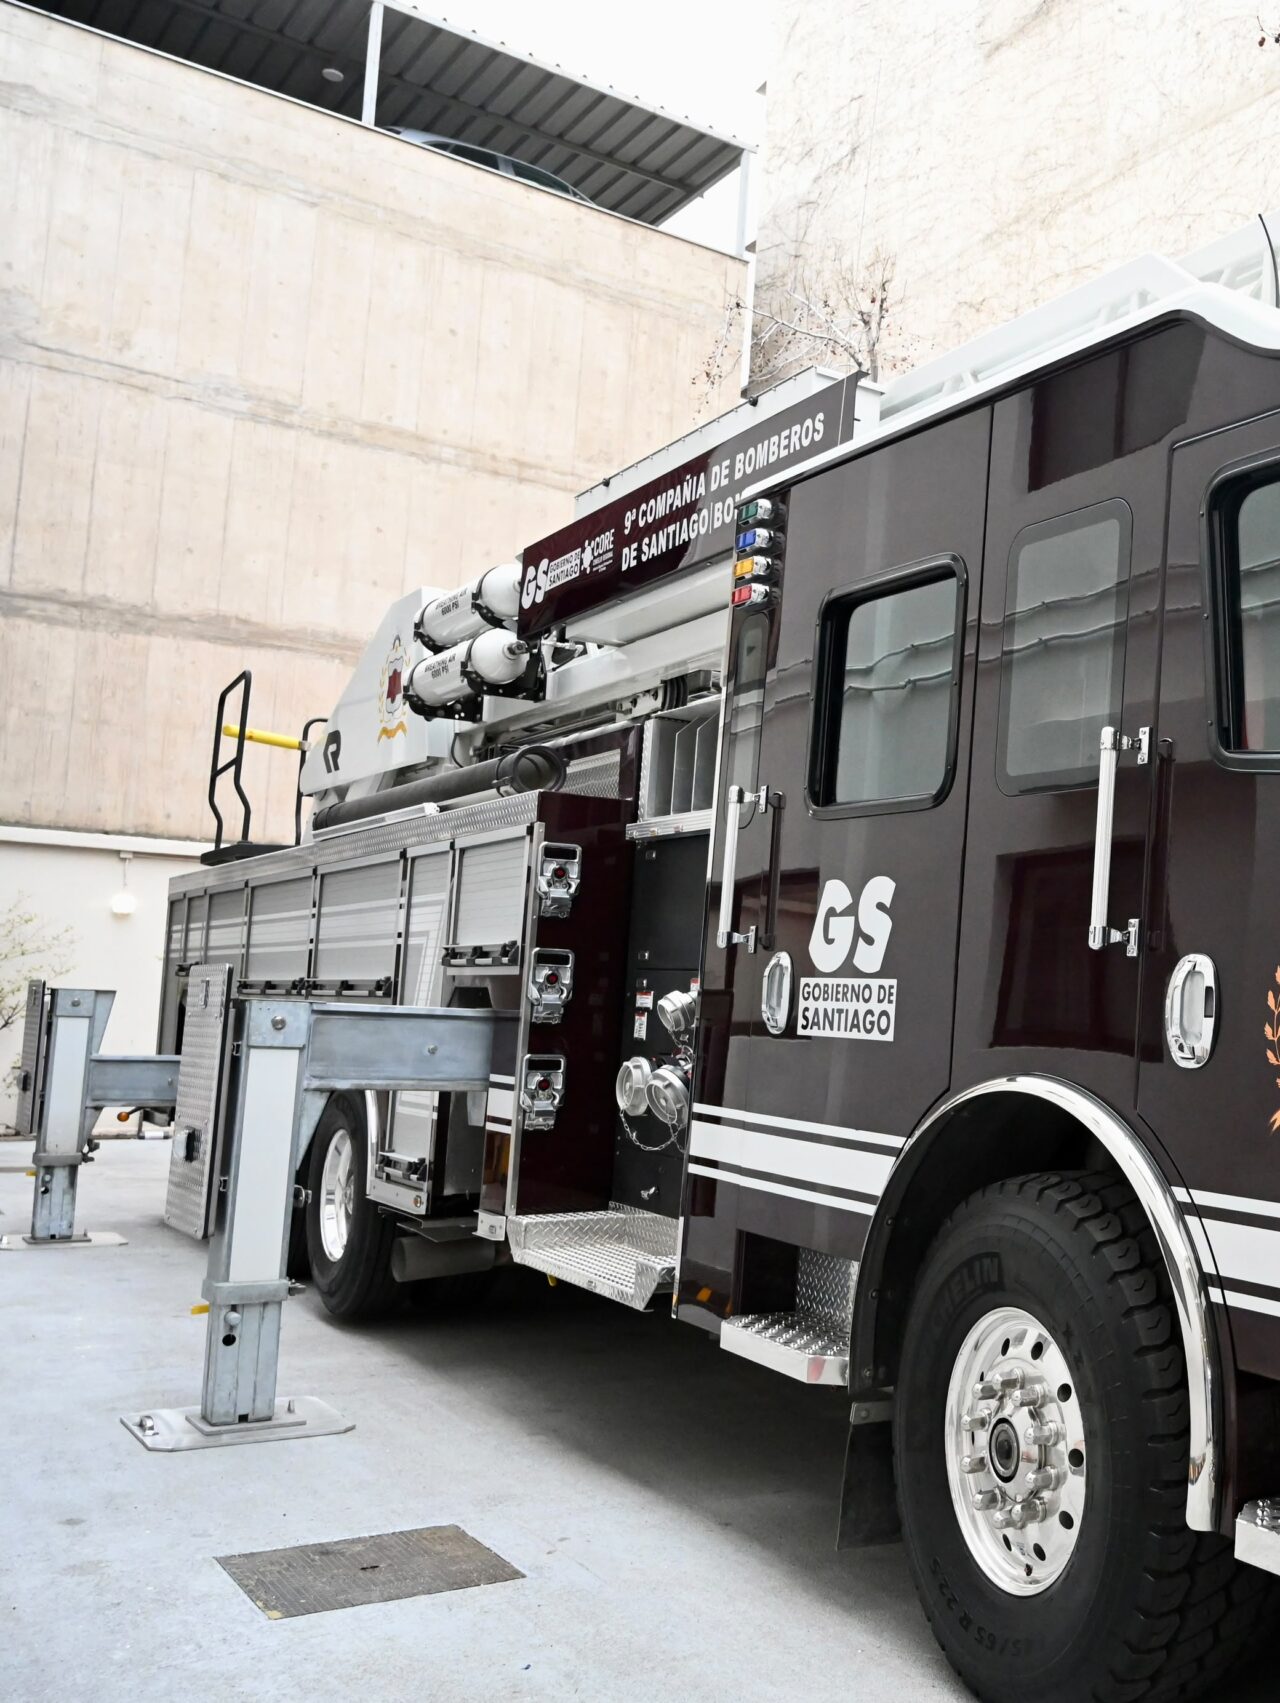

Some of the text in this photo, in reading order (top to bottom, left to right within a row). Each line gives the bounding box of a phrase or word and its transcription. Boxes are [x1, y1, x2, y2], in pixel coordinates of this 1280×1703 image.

[710, 459, 730, 492] DE
[734, 412, 825, 481] BOMBEROS
[593, 528, 615, 557] CORE
[621, 542, 638, 571] DE
[641, 508, 709, 562] SANTIAGO
[549, 563, 579, 587] SANTIAGO
[550, 554, 573, 573] GOBIERNO
[574, 551, 580, 561] DE
[521, 558, 549, 609] GS
[808, 875, 897, 974] GS
[801, 982, 895, 1004] GOBIERNO DE
[800, 1006, 891, 1036] SANTIAGO
